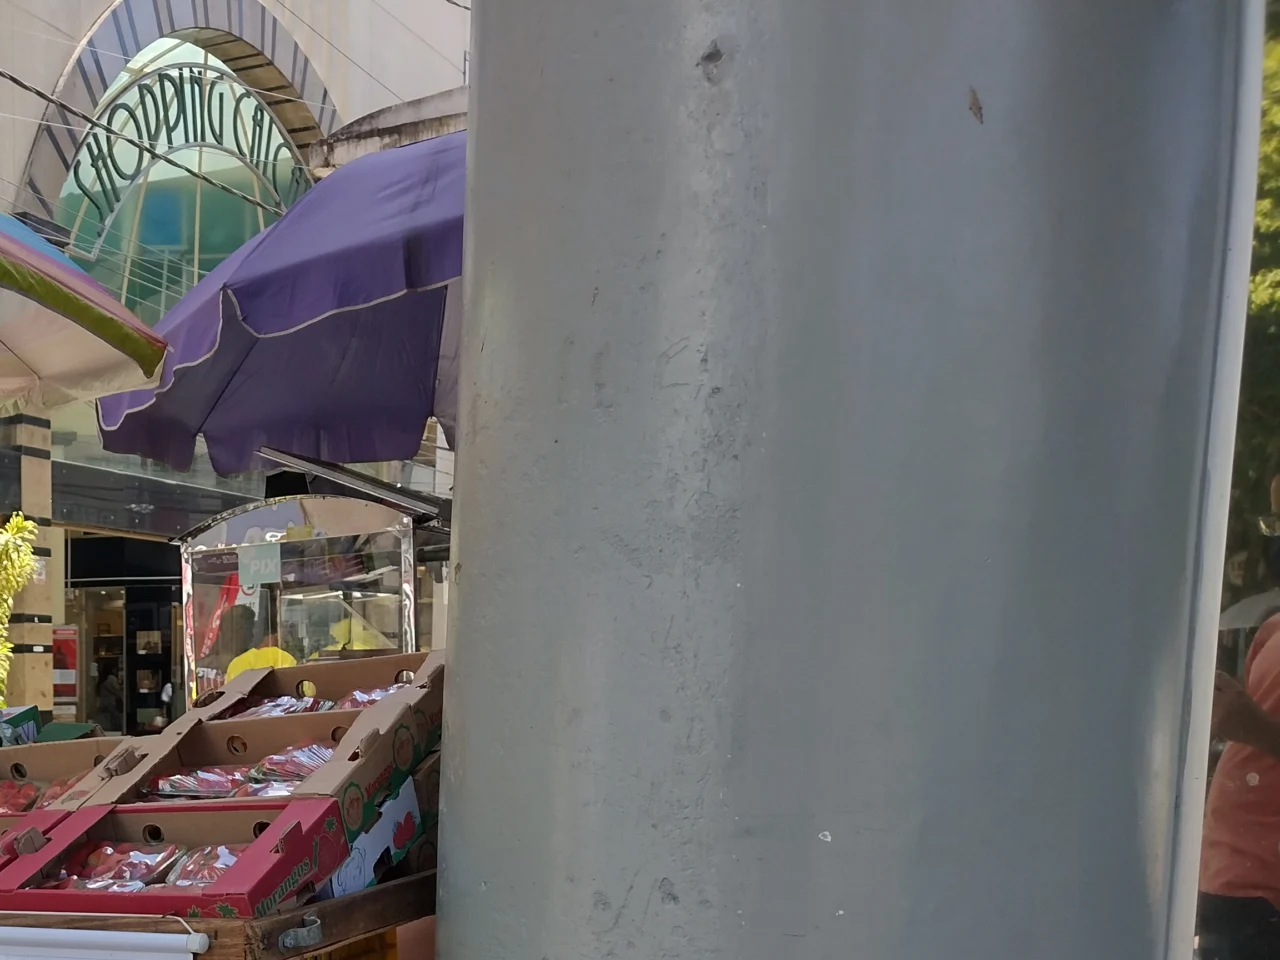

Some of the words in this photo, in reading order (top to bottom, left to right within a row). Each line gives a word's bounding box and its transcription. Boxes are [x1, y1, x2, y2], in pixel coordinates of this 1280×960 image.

[73, 67, 224, 238] SHOPPING
[250, 559, 278, 574] PIX
[254, 857, 310, 918] Morangos
